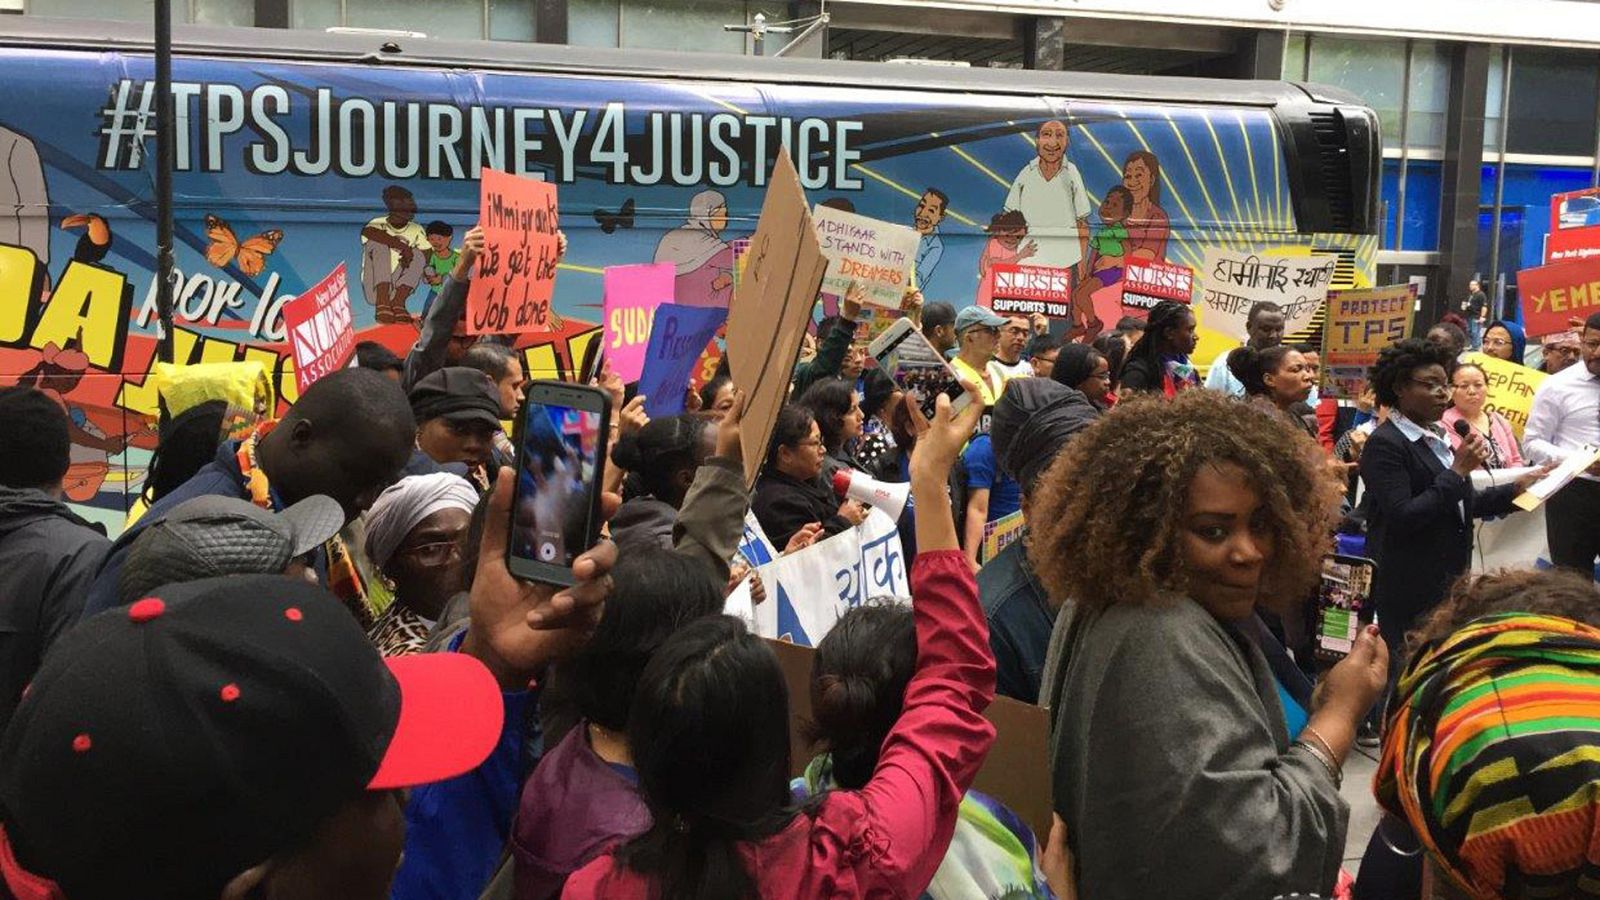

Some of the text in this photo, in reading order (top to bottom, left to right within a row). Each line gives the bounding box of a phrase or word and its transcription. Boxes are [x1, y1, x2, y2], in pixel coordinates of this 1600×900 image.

[821, 236, 906, 264] STANDS WITH
[504, 246, 531, 285] get
[536, 245, 557, 281] the
[995, 272, 1068, 292] NURSES
[1126, 264, 1192, 291] NURSES
[993, 288, 1068, 299] ASSOCIATION
[1124, 281, 1191, 298] ASSOCIATION
[474, 282, 548, 331] Job done
[993, 299, 1066, 316] SUPPORTS YOU
[1341, 297, 1407, 315] PROTECT
[1335, 317, 1406, 344] TPS
